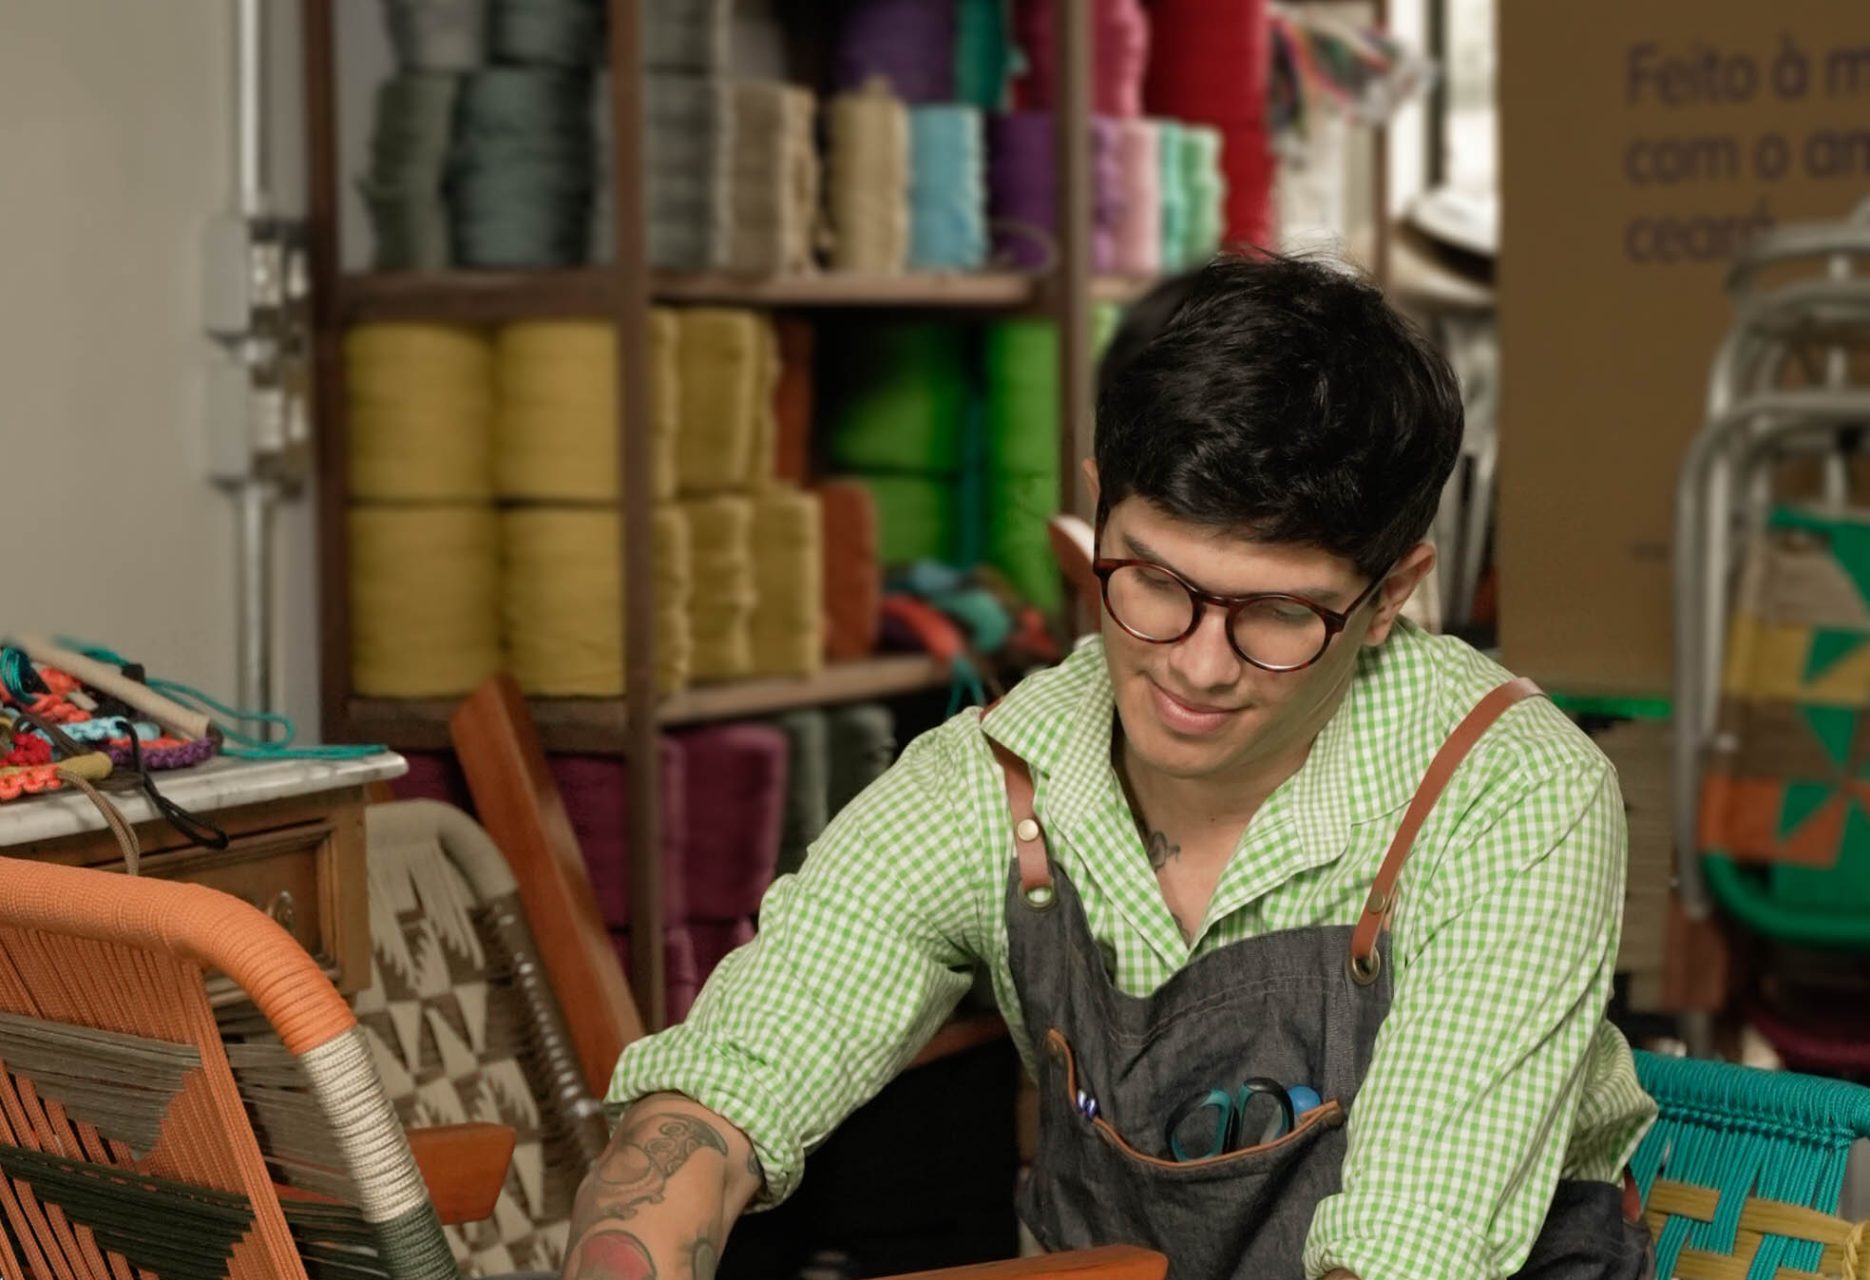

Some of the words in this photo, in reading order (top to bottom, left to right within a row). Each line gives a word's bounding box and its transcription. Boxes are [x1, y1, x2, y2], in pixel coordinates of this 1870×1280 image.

[1626, 42, 1758, 106] Feito
[1625, 137, 1738, 185] com
[1754, 132, 1790, 181] o
